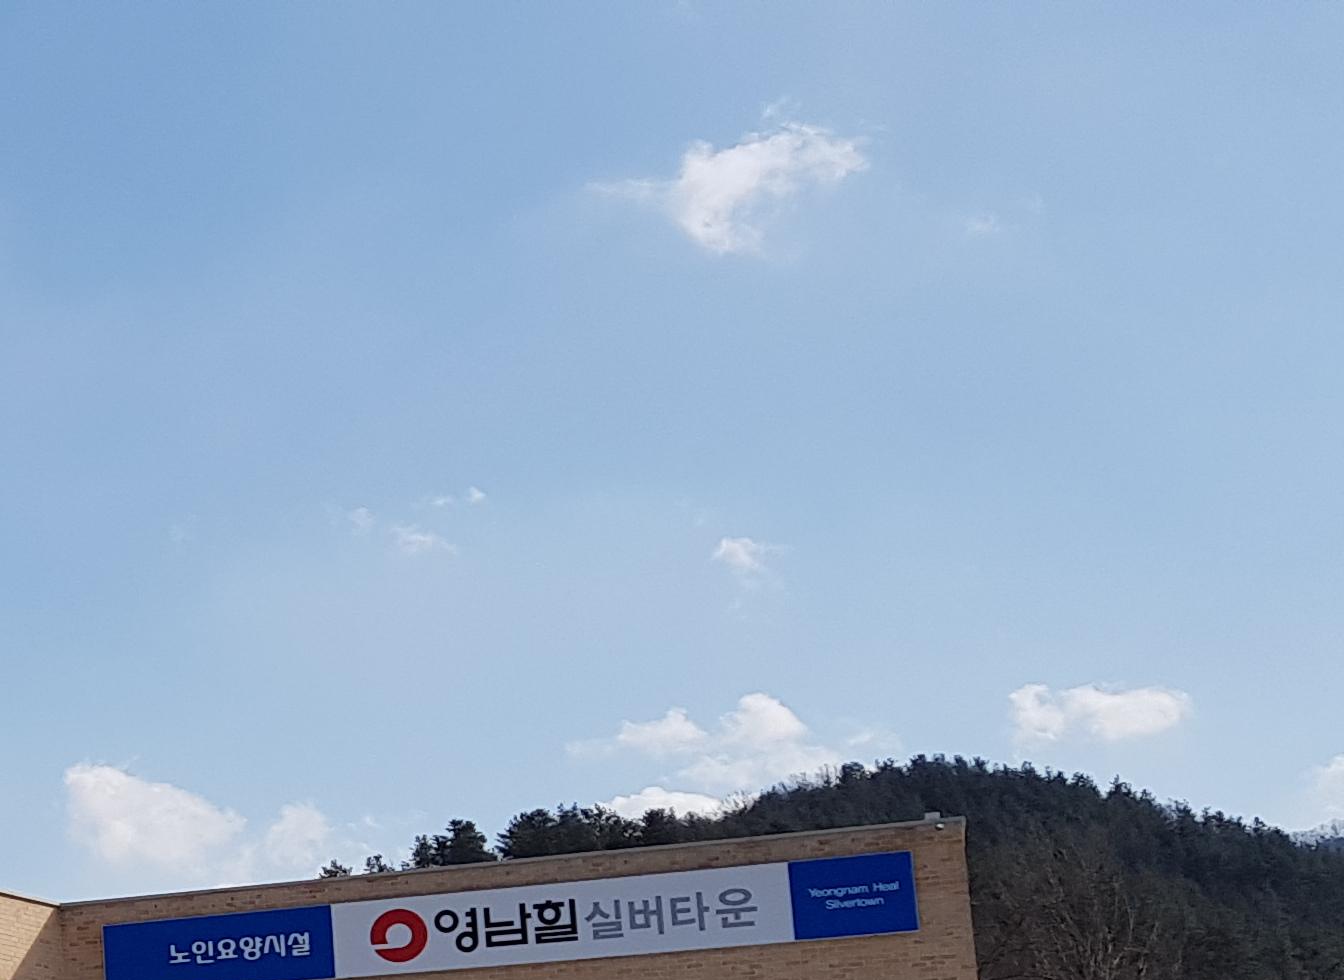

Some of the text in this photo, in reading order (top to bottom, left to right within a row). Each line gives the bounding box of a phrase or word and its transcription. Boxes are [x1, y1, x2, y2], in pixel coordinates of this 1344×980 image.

[808, 880, 900, 898] Yeongnam Heal
[825, 896, 885, 911] Silvertown
[168, 931, 312, 965] 노인요양시설
